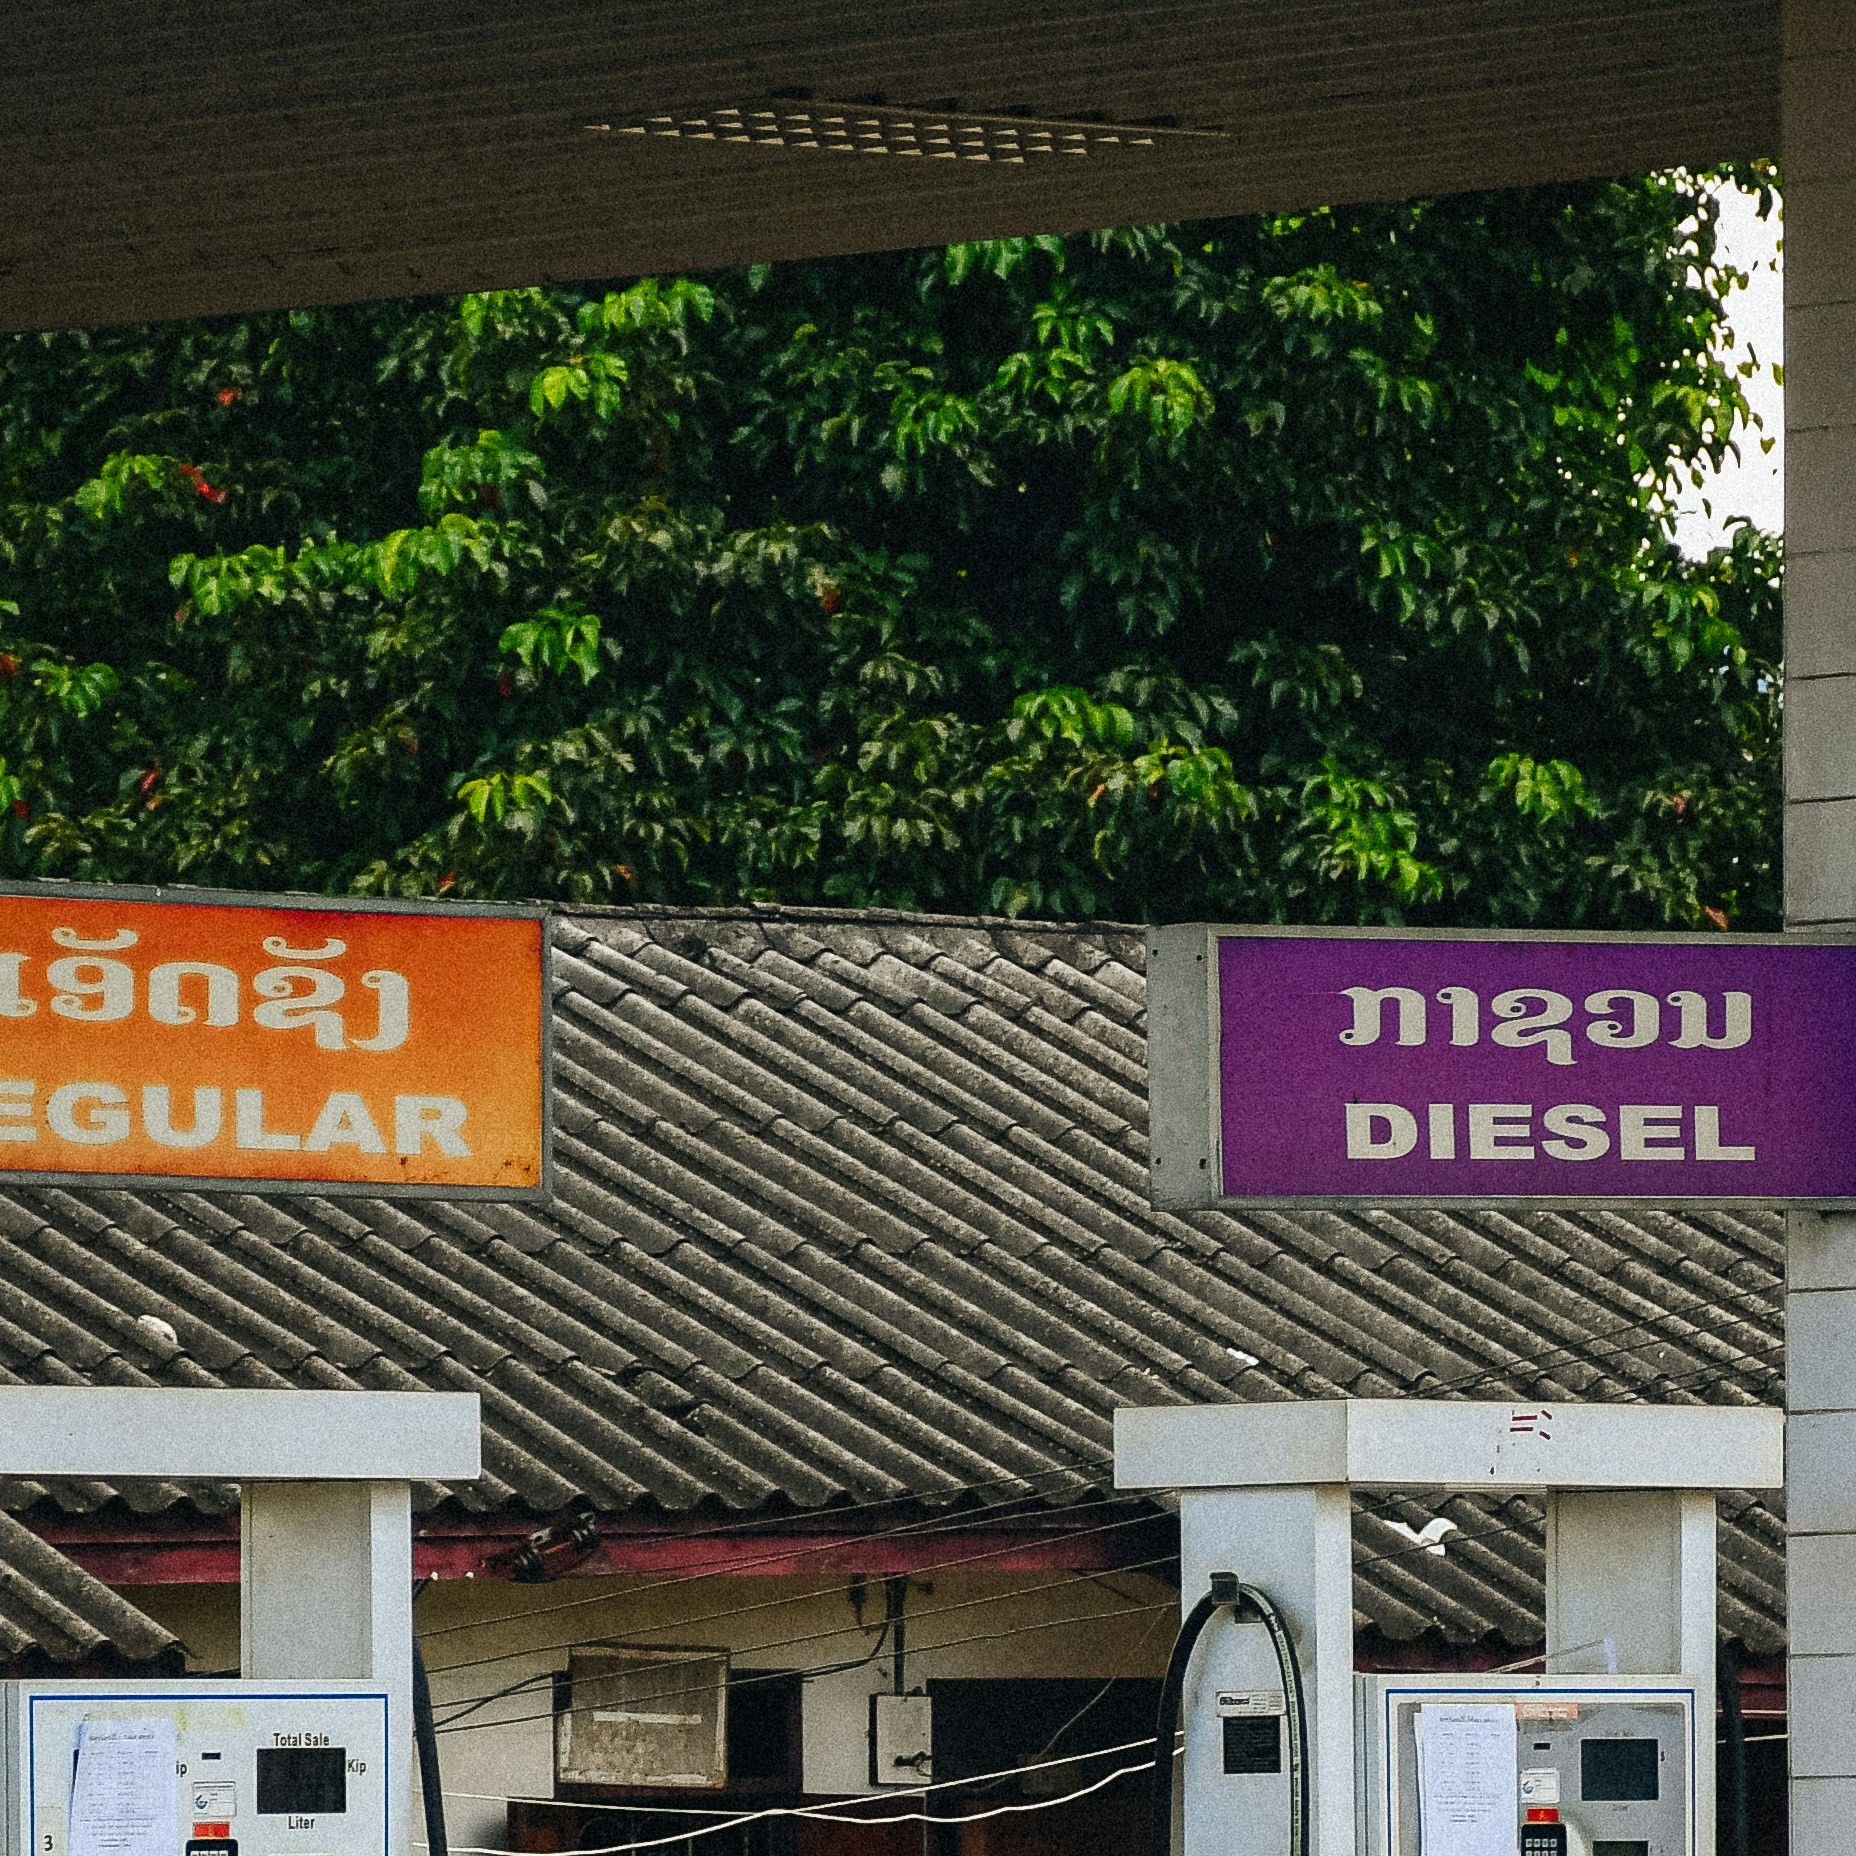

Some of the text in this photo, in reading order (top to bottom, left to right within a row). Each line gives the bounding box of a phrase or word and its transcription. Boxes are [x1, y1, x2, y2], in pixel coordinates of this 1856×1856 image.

[1344, 1102, 1756, 1162] DIESEL
[273, 1732, 329, 1746] Total Sale
[175, 1761, 188, 1777] ip
[347, 1759, 367, 1775] Kip
[288, 1816, 315, 1830] Liter
[44, 1835, 54, 1851] 3
